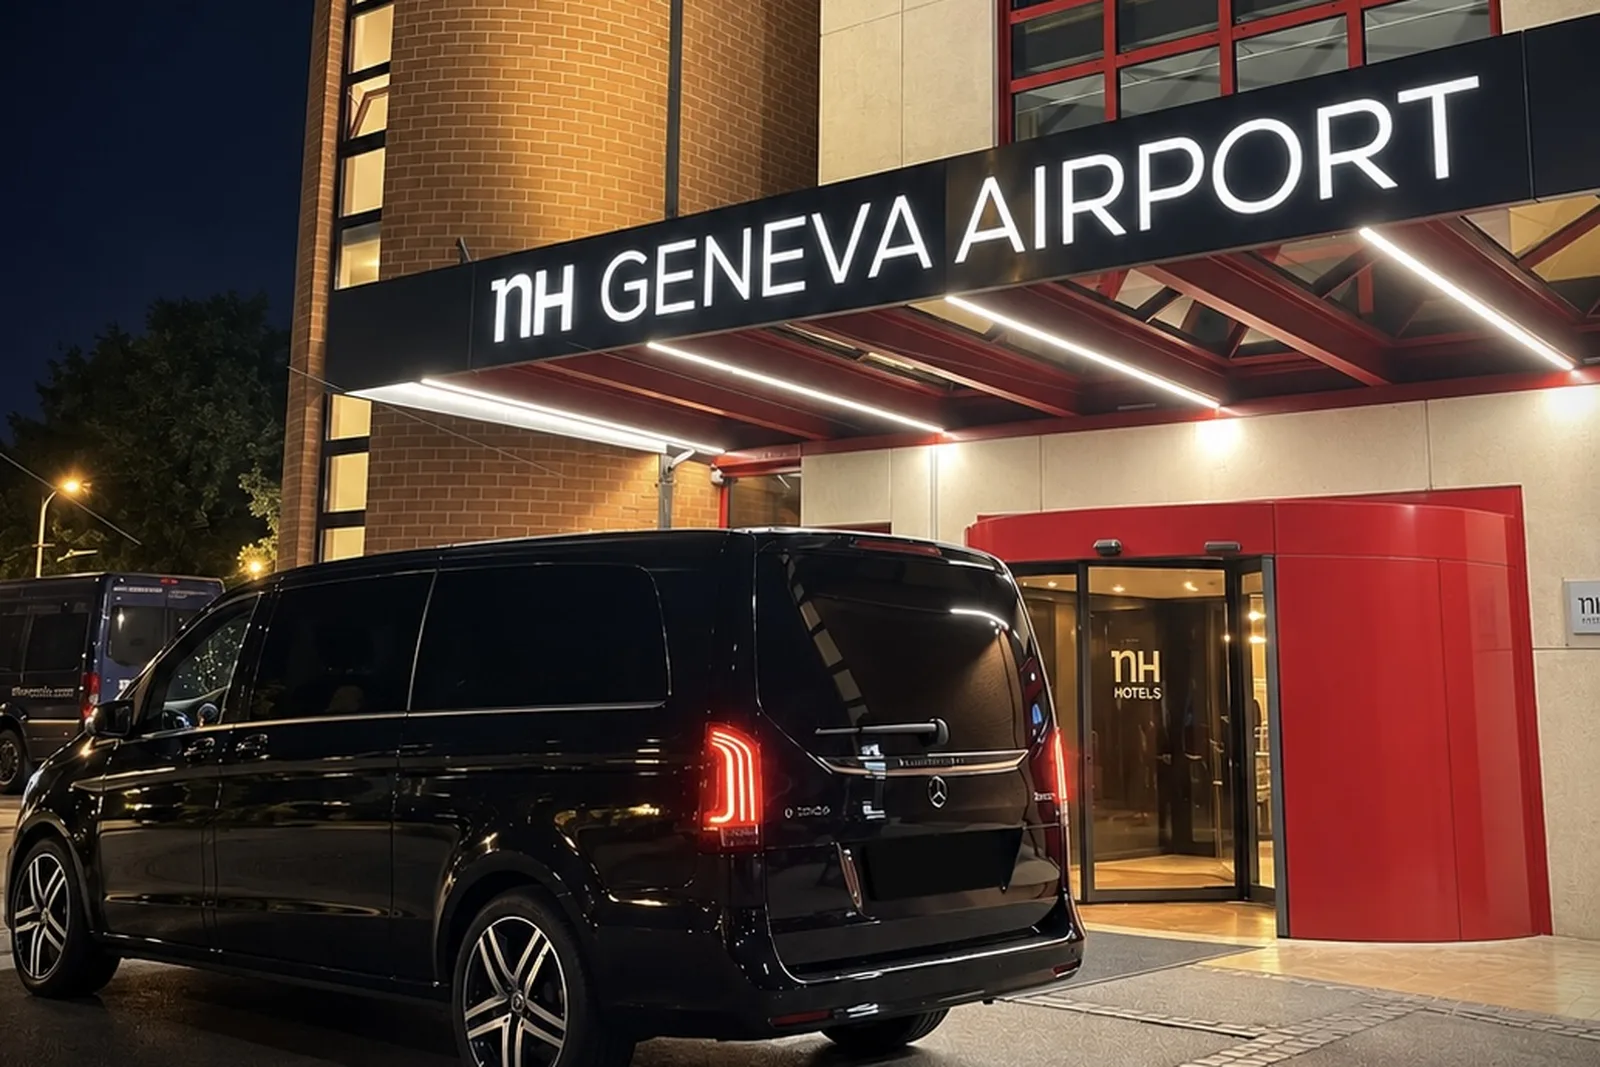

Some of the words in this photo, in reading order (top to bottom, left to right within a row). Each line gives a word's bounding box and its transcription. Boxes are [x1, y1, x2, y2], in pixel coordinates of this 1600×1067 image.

[601, 195, 932, 323] GENEVA
[954, 75, 1480, 264] AIRPORT
[1113, 687, 1162, 700] HOTELS
